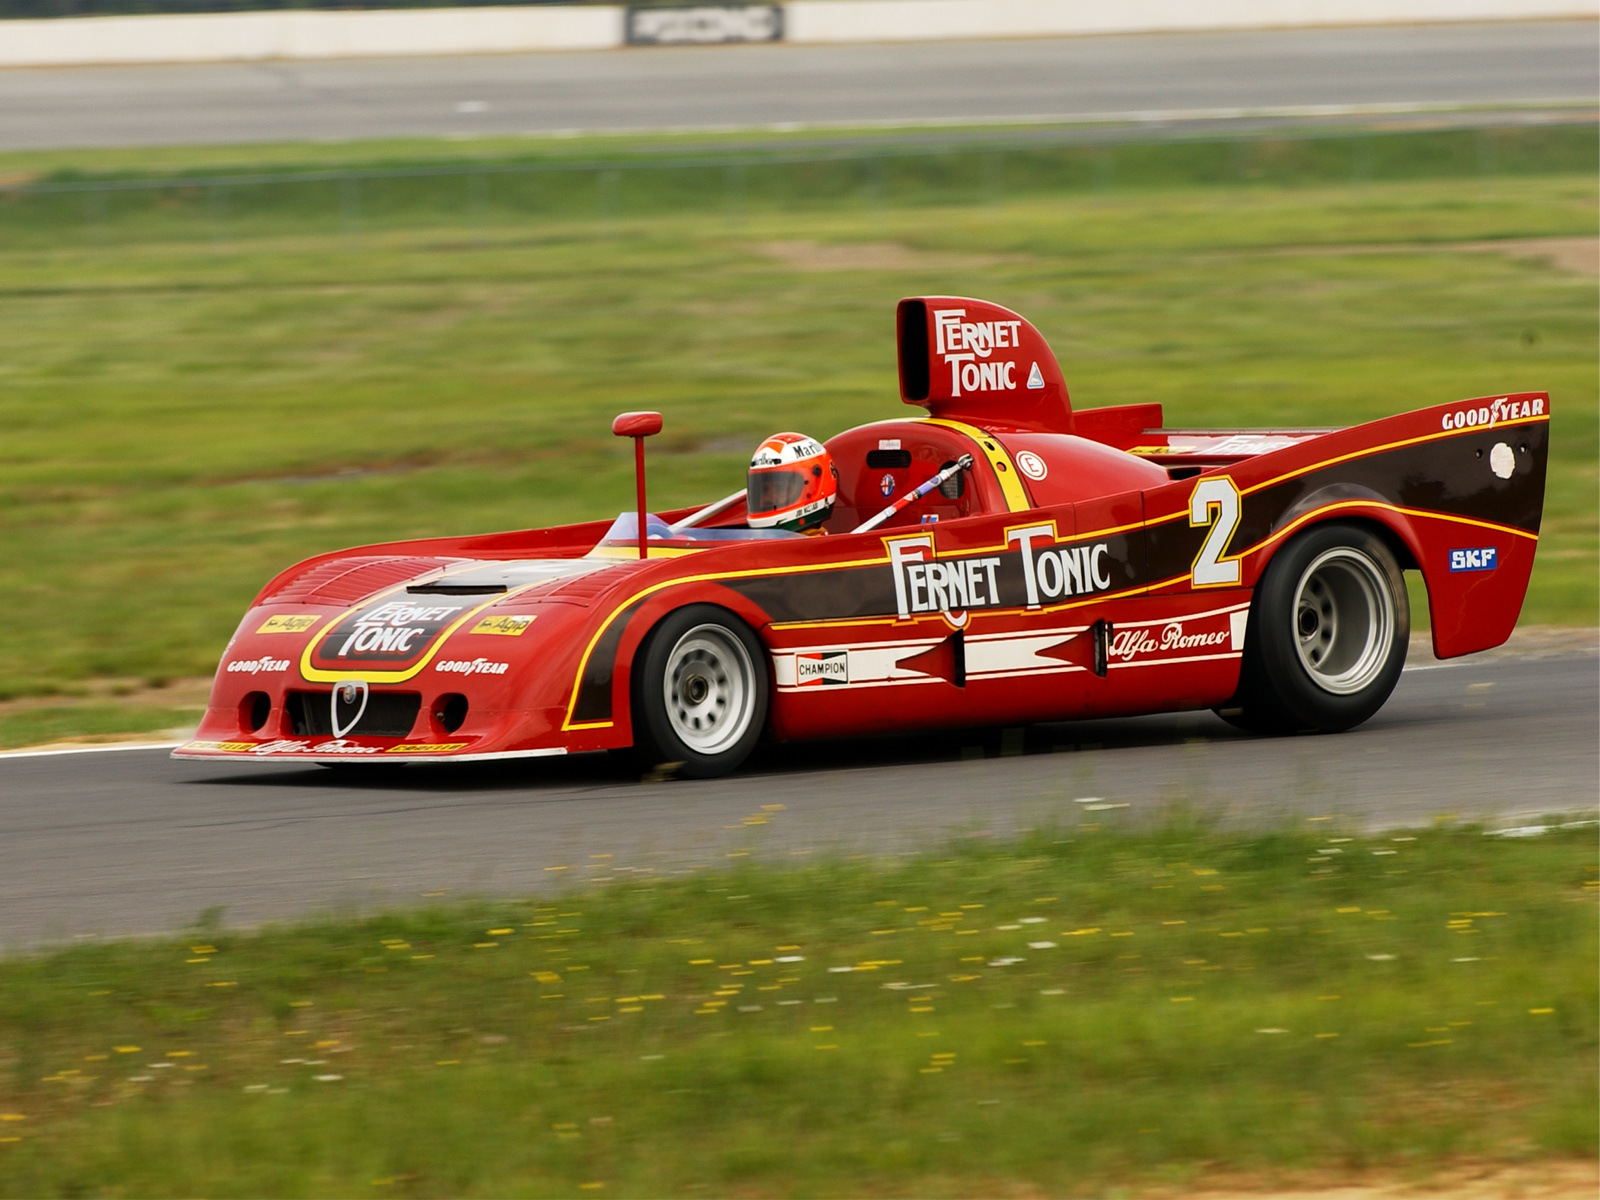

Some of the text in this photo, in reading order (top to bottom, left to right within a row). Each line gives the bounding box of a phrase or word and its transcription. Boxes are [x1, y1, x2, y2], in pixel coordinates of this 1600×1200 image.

[934, 309, 1021, 357] FERNET
[945, 353, 1016, 397] TONIC
[1025, 457, 1040, 472] E
[1190, 477, 1242, 586] 2
[1452, 549, 1495, 569] SKF
[888, 524, 1111, 627] FERNET TONIC
[278, 617, 315, 631] Agip
[356, 602, 463, 626] FERNET
[493, 616, 530, 633] Agip
[338, 622, 425, 656] TONIC
[1109, 622, 1230, 661] Alfa Romeo
[799, 662, 846, 676] CHAMPION
